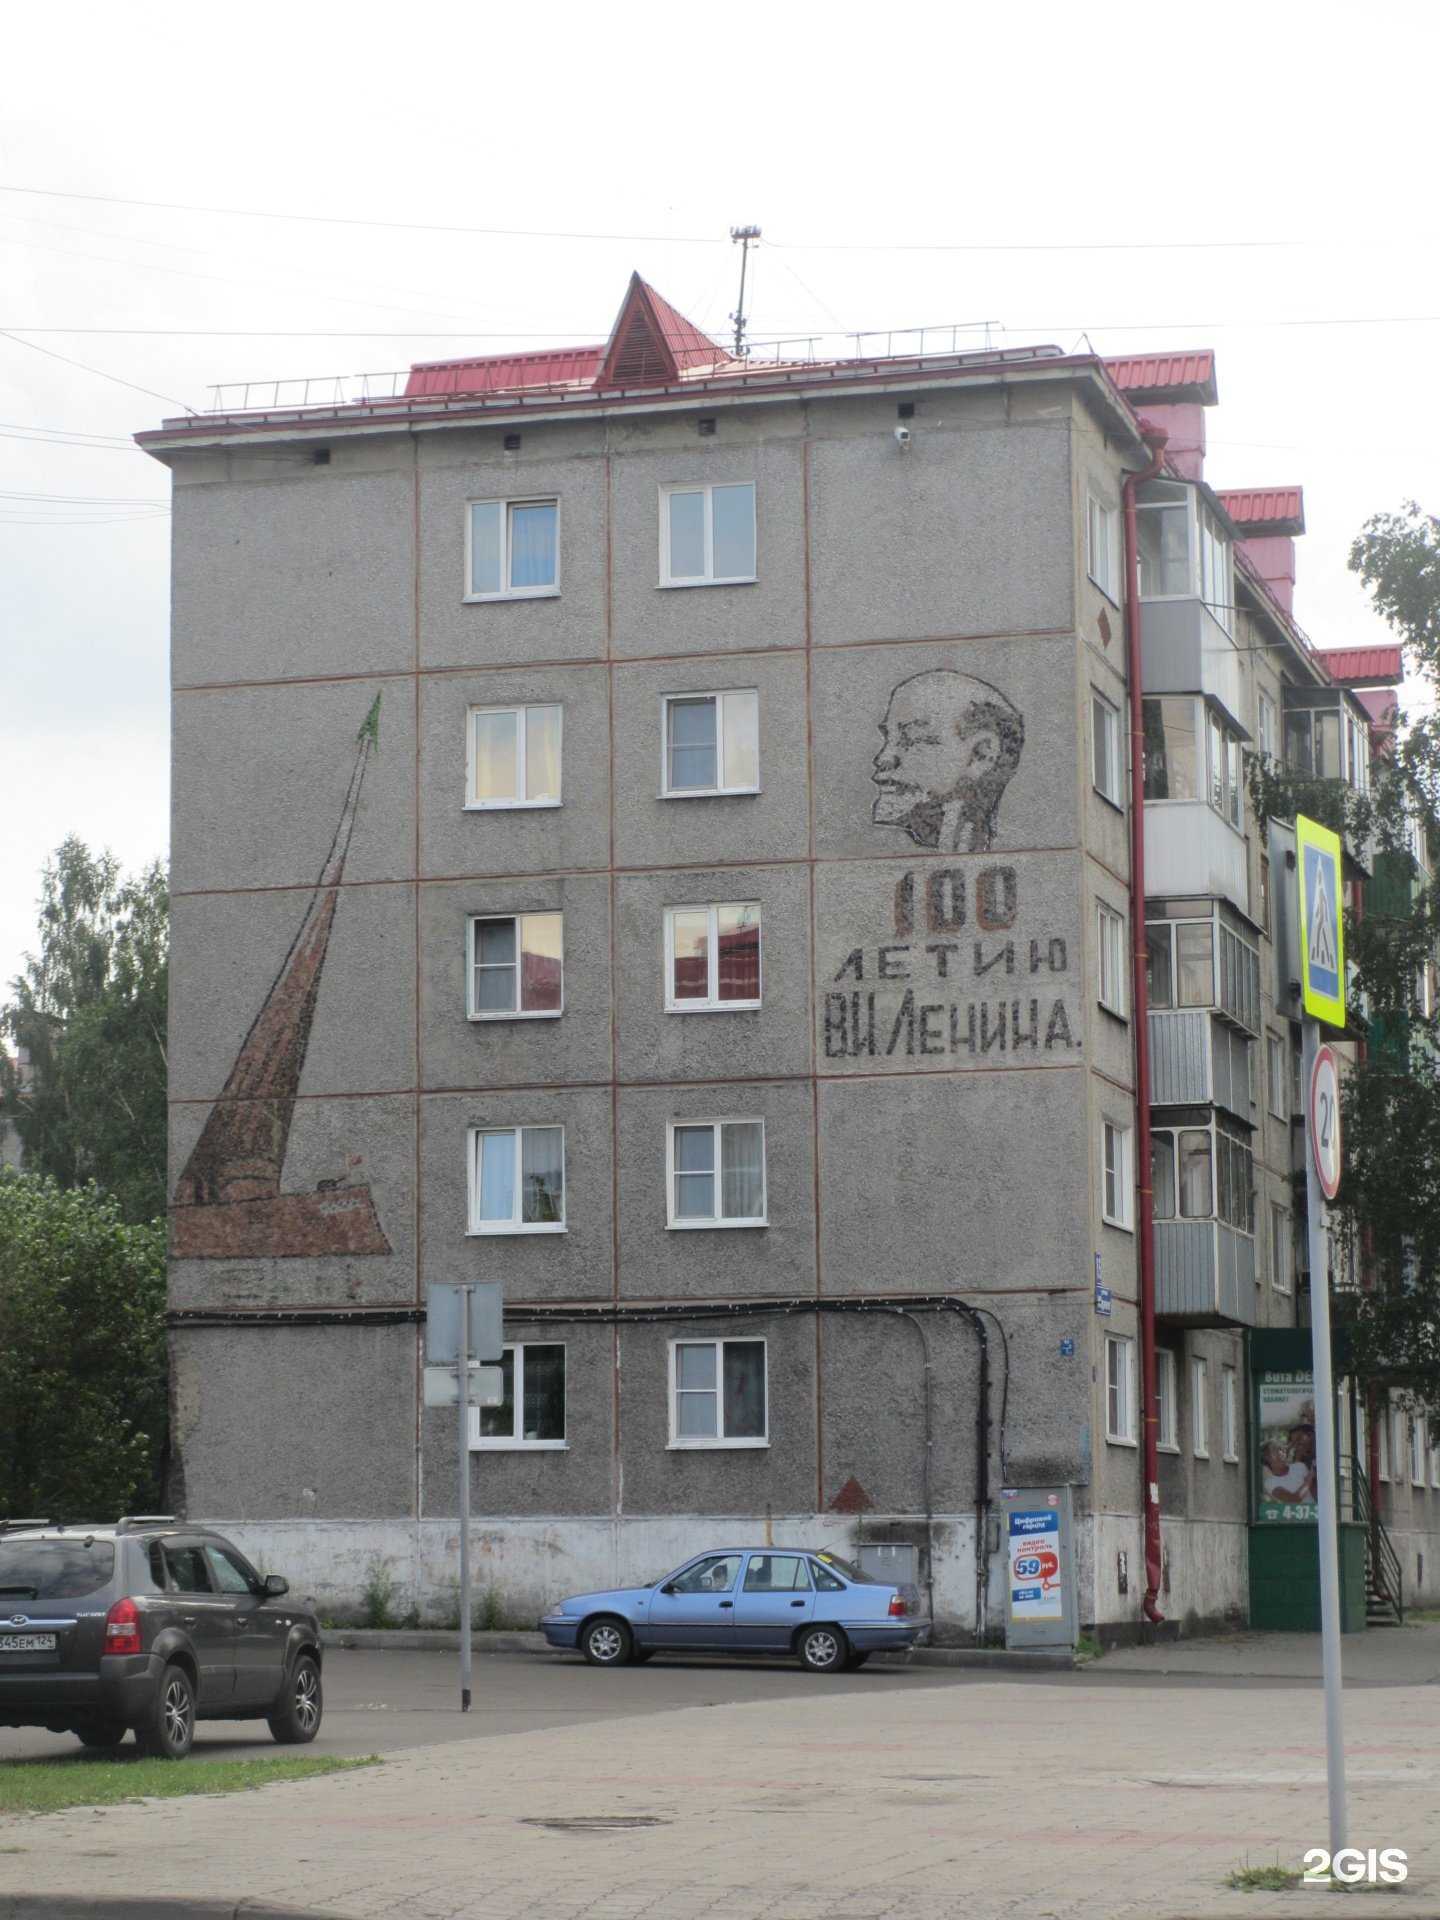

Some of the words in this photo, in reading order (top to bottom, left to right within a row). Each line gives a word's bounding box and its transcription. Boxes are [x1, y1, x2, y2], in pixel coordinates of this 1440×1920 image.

[894, 865, 1017, 937] 100
[834, 938, 1068, 982] ЛЕТИЮ
[1016, 1559, 1040, 1575] 59
